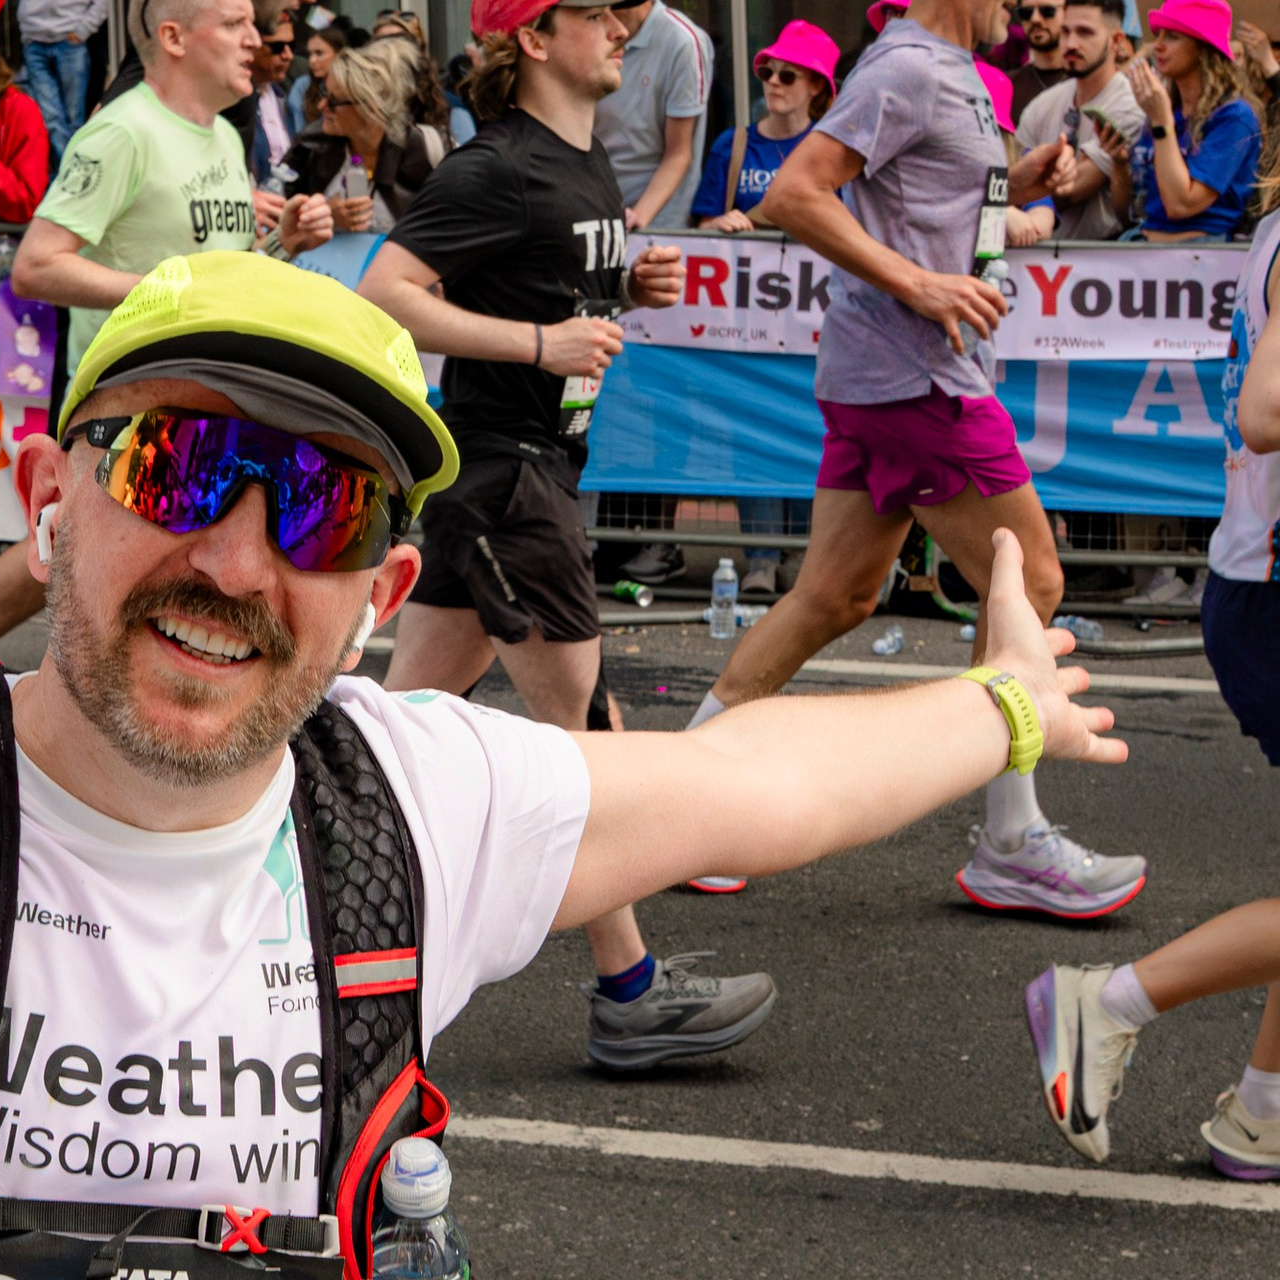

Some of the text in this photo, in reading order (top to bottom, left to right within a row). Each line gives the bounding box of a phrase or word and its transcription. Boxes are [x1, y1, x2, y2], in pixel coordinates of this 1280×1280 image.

[683, 254, 832, 313] Risk
[1025, 263, 1239, 333] Young
[708, 326, 768, 342] @CRY_UK
[1034, 335, 1106, 351] #12AWeek
[16, 901, 112, 940] Weather
